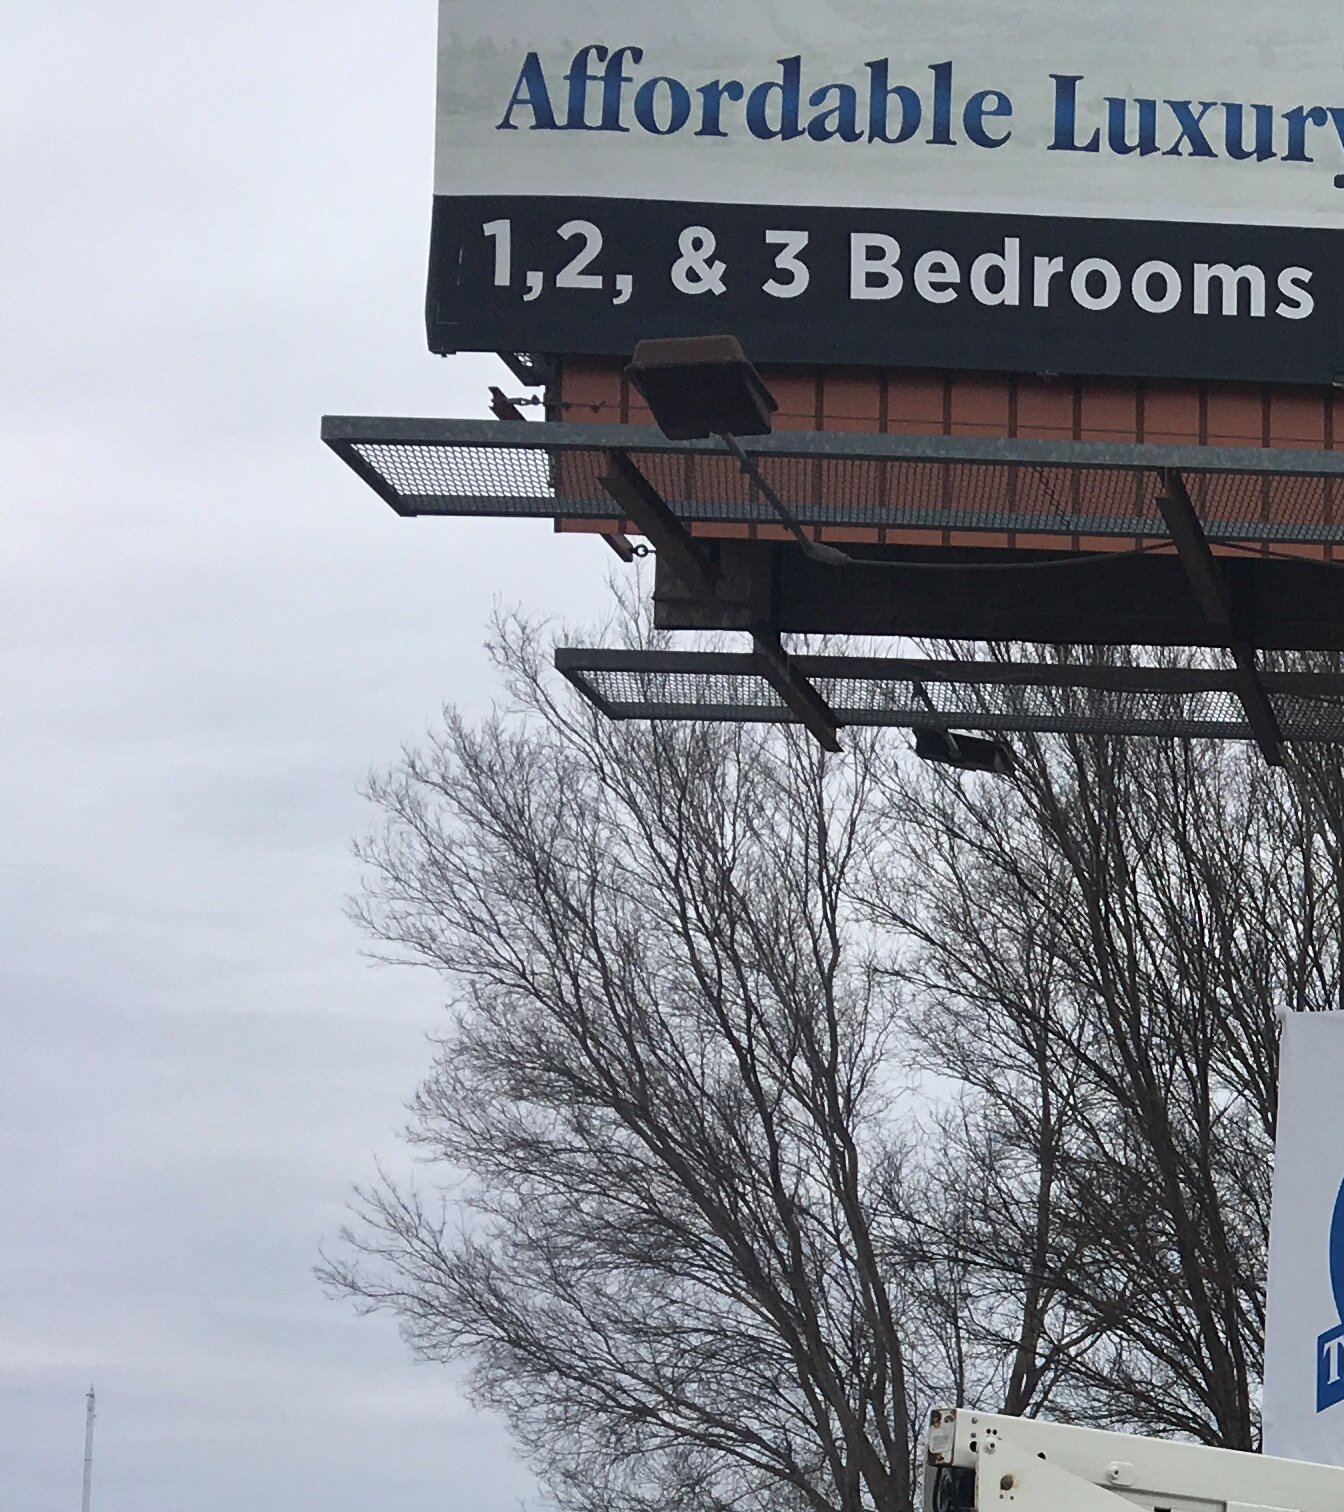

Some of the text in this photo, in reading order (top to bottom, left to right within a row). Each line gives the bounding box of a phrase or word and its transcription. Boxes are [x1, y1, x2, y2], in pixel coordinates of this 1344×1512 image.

[496, 45, 1012, 148] Affordable
[671, 226, 726, 295] &
[762, 230, 809, 298] 3
[851, 232, 1315, 319] Bedrooms
